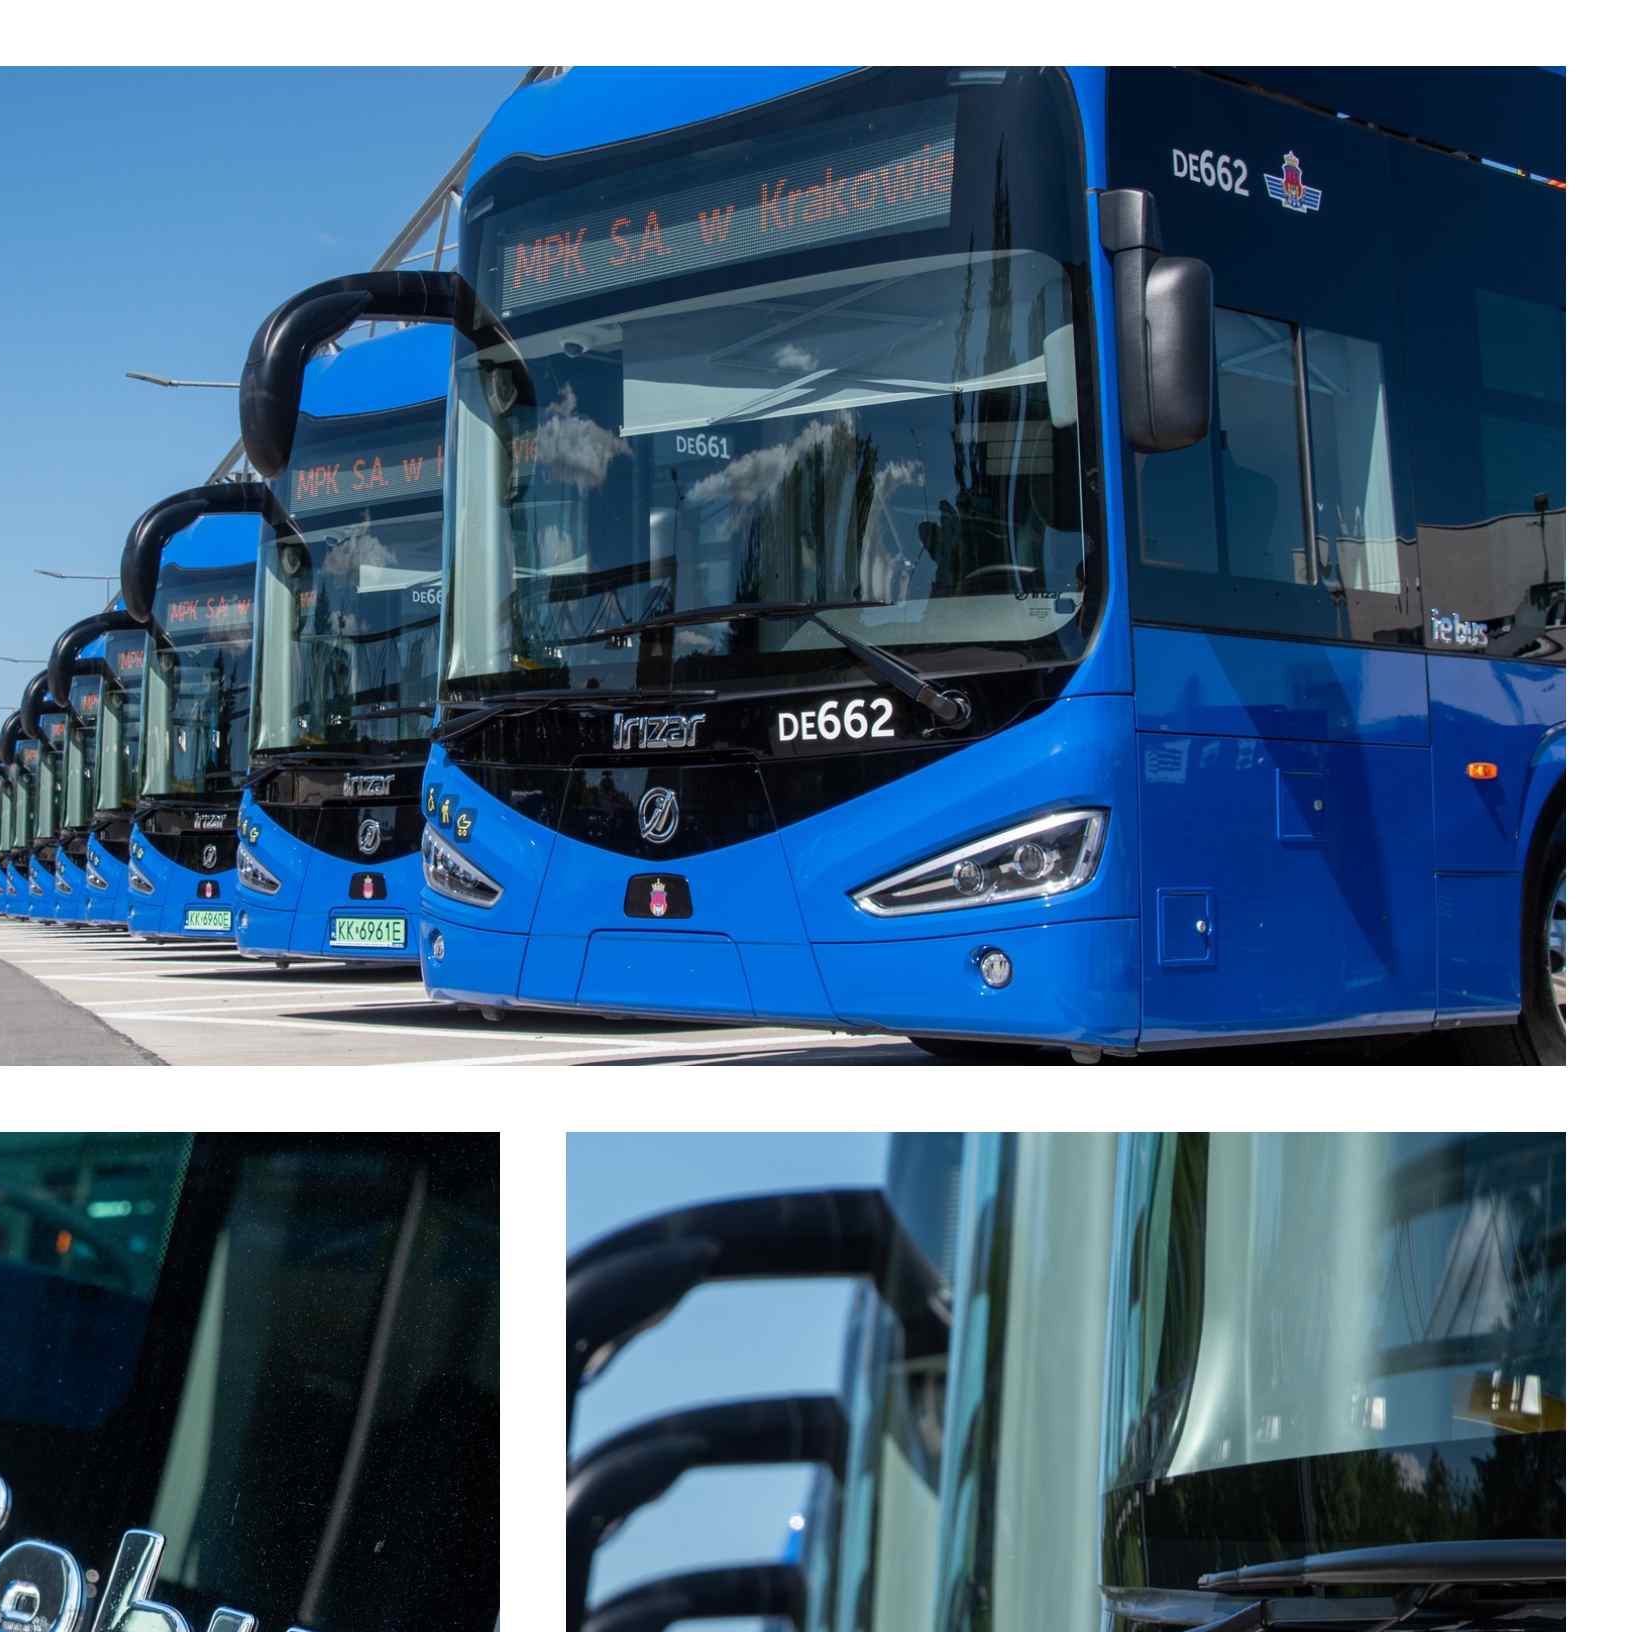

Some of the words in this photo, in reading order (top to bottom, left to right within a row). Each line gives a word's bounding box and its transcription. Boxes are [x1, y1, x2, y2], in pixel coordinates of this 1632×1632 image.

[1172, 148, 1250, 197] DE662
[512, 226, 588, 289] MPK
[697, 203, 737, 246] w
[757, 143, 954, 232] Krakowie
[676, 433, 731, 460] DE661
[295, 463, 340, 503] MPK
[412, 588, 444, 605] DE66
[778, 698, 896, 742] DE662
[337, 920, 354, 940] KK
[359, 920, 401, 942] 6961E
